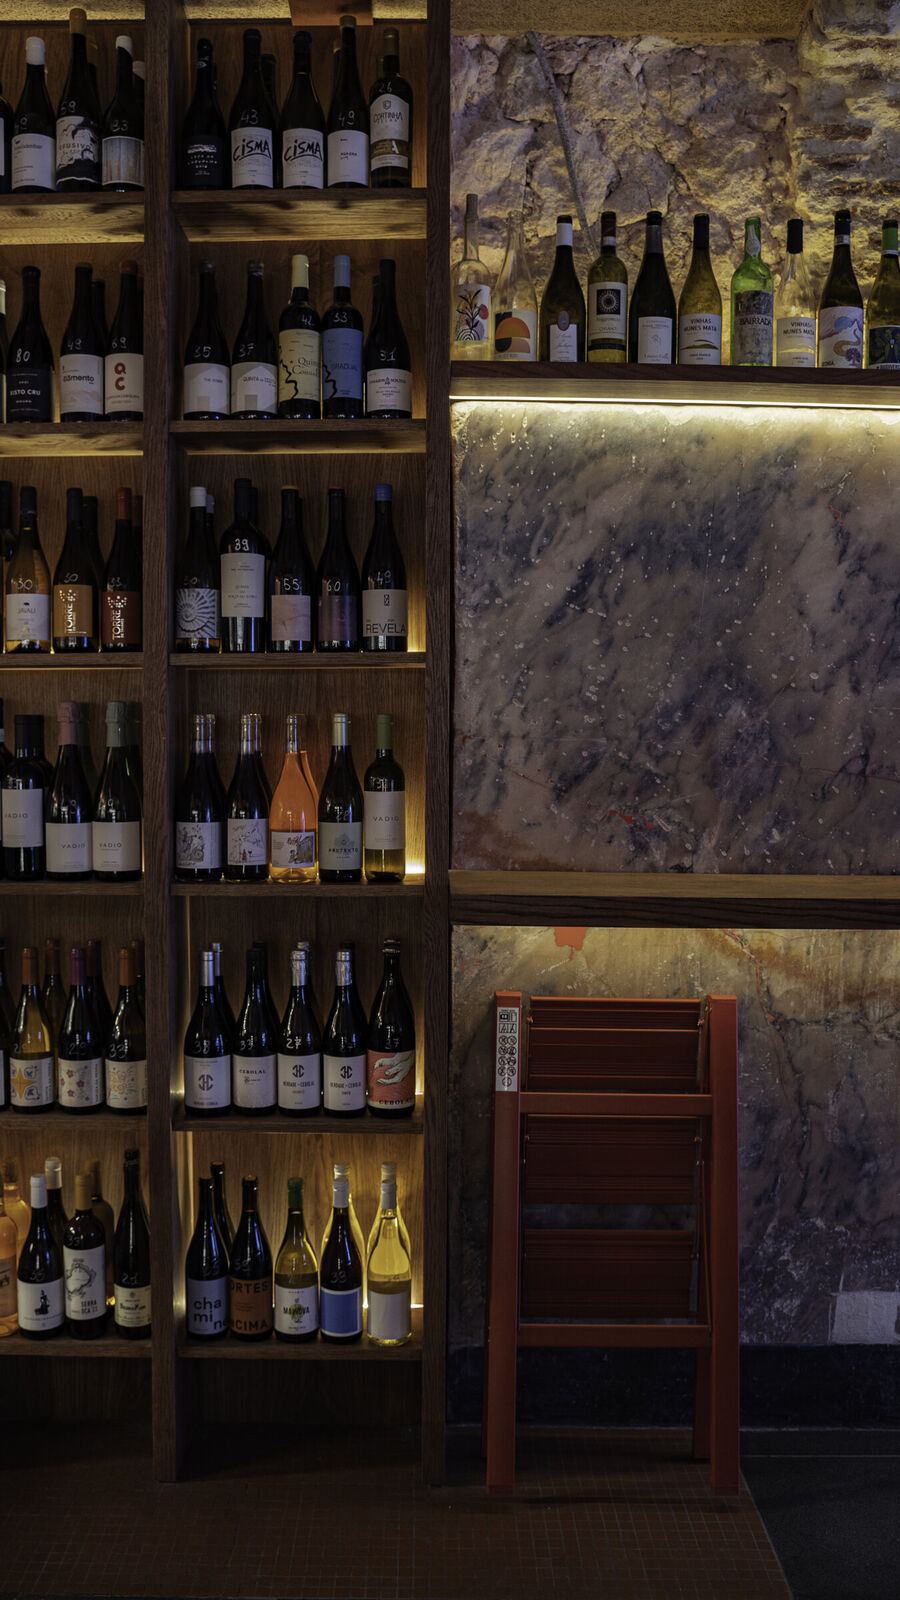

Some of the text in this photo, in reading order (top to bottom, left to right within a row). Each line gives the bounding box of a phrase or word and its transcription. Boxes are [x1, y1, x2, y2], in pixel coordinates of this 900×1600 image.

[16, 349, 31, 363] 80
[193, 1297, 223, 1311] cha
[193, 1309, 214, 1323] mi
